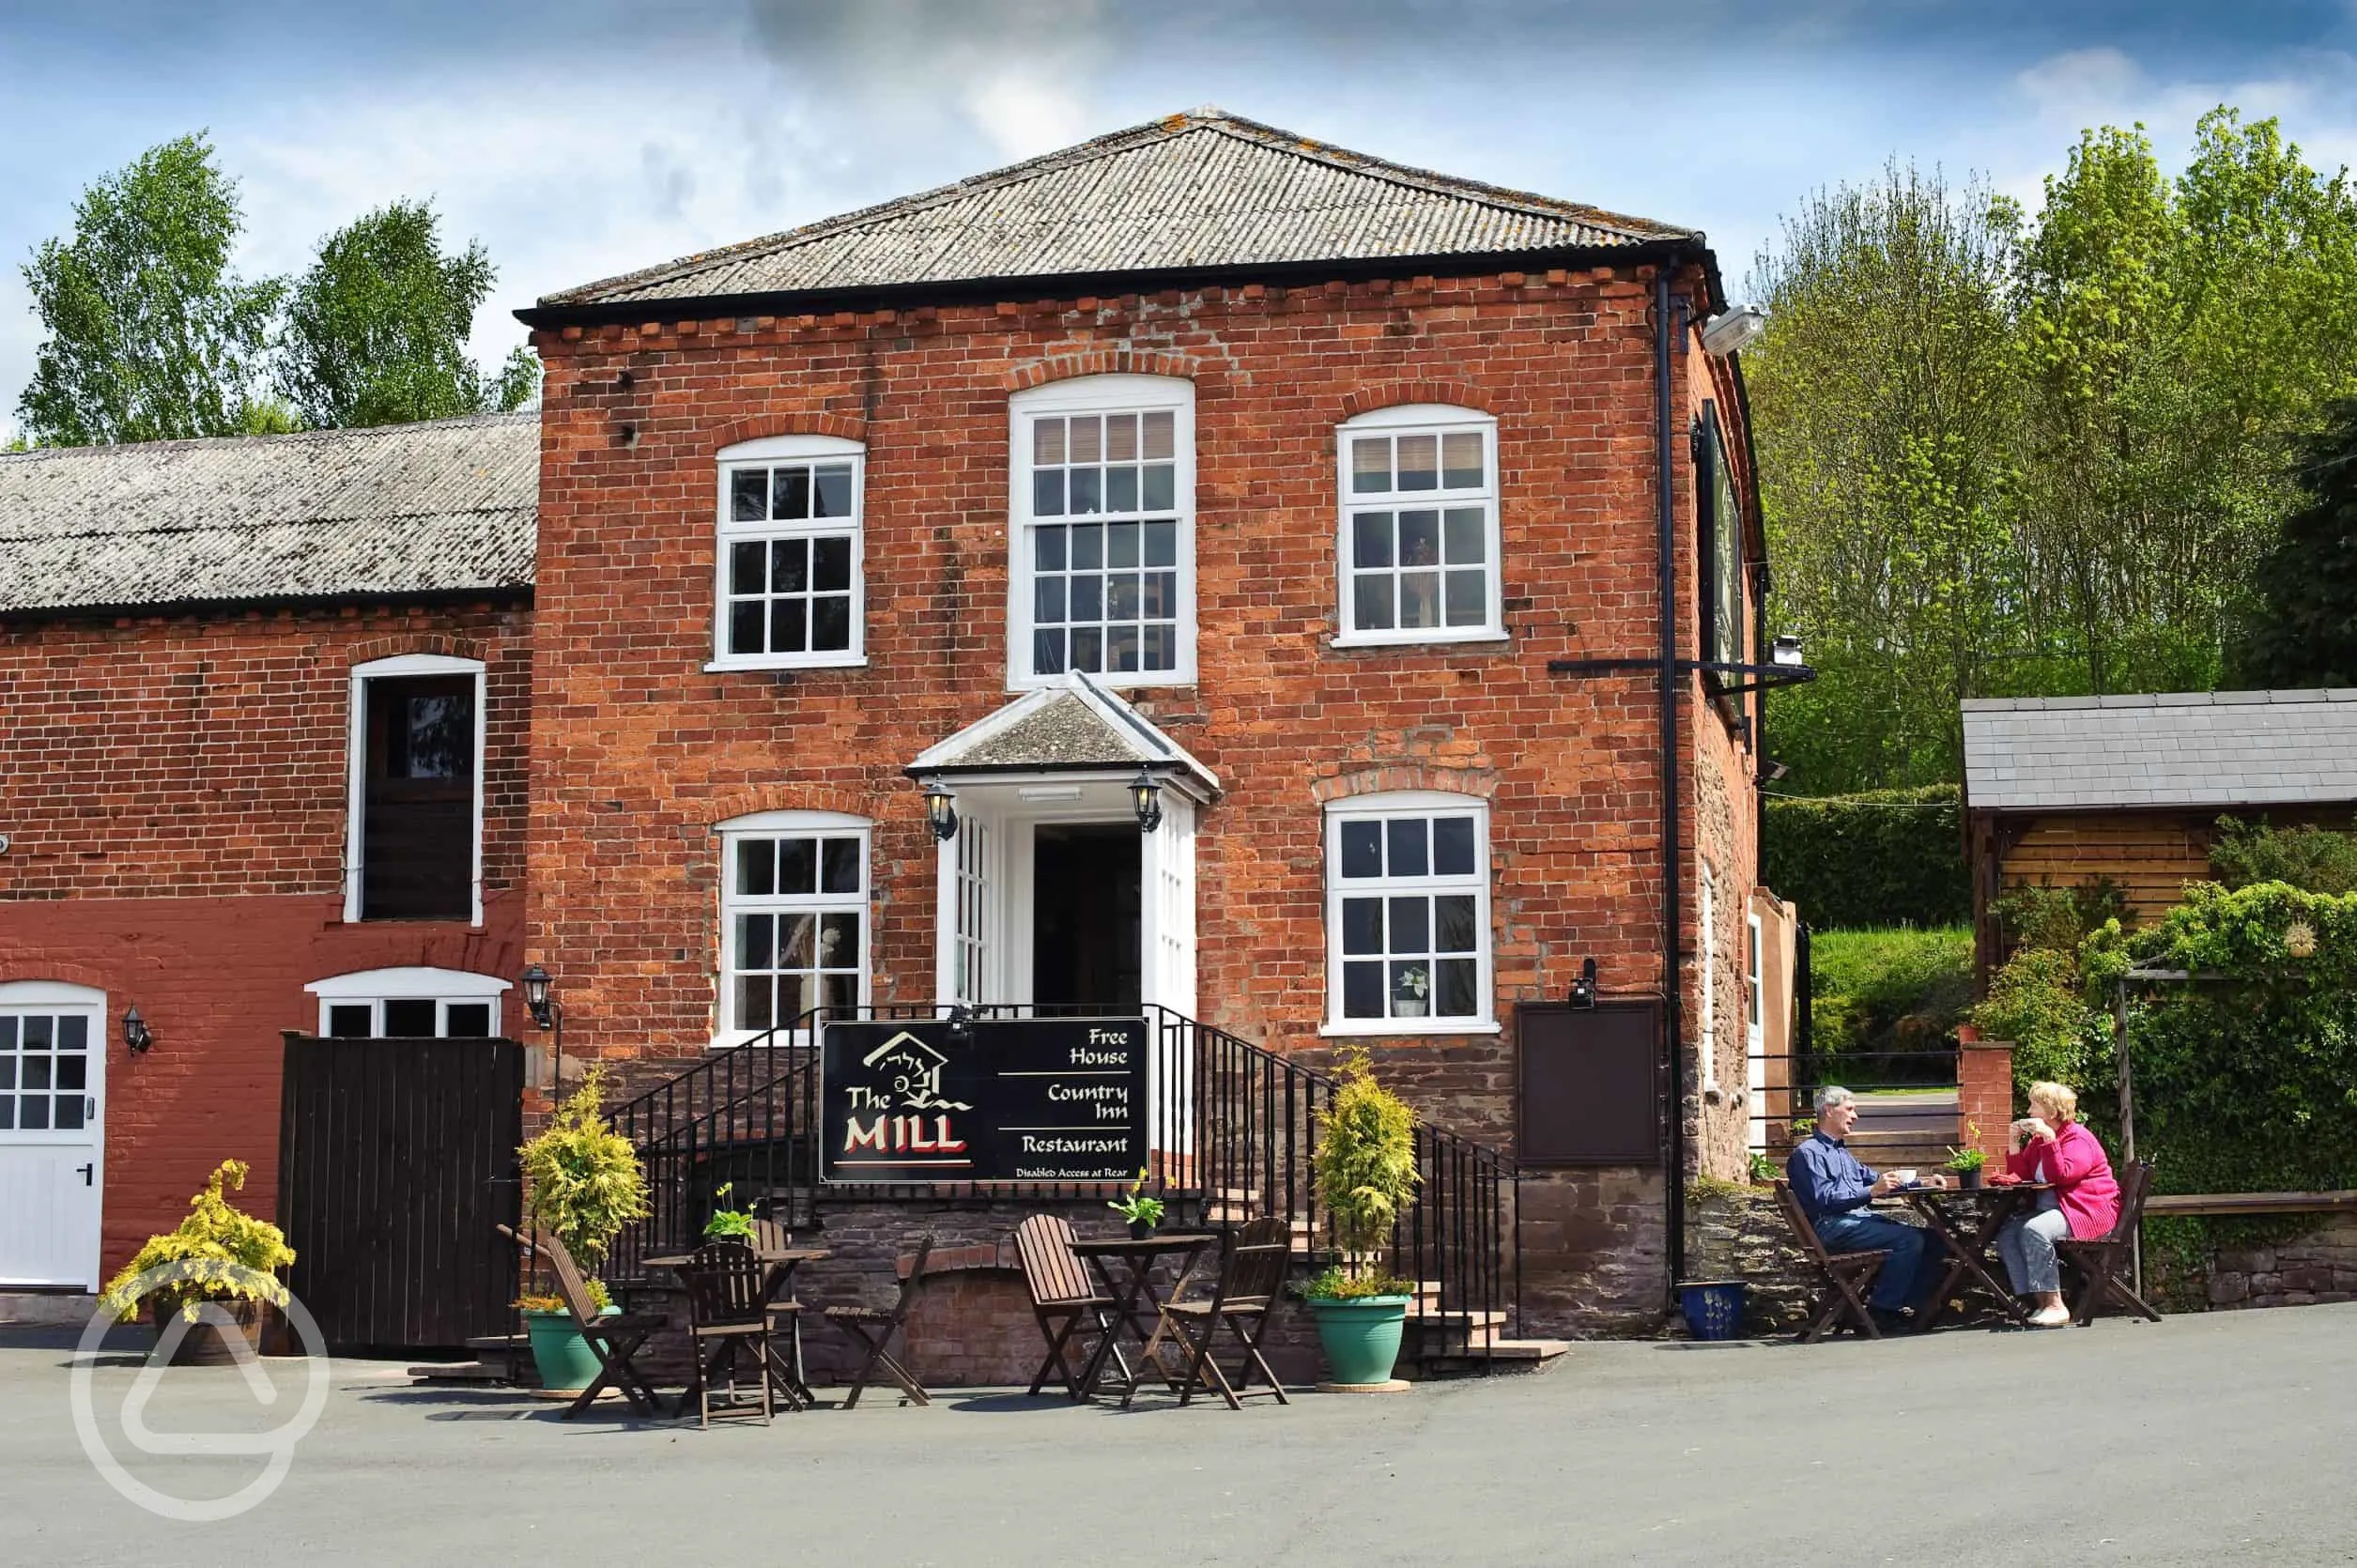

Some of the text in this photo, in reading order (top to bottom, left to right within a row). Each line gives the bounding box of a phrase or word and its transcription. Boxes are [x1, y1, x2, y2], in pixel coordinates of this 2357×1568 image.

[1088, 1028, 1128, 1045] Free
[1070, 1048, 1128, 1066] House
[845, 1086, 891, 1110] The
[1048, 1084, 1128, 1102] Country
[1095, 1104, 1128, 1120] Inn
[844, 1115, 967, 1154] MILL
[1022, 1135, 1128, 1153] Restaurant
[1016, 1167, 1128, 1177] Disabled Access at Rear
